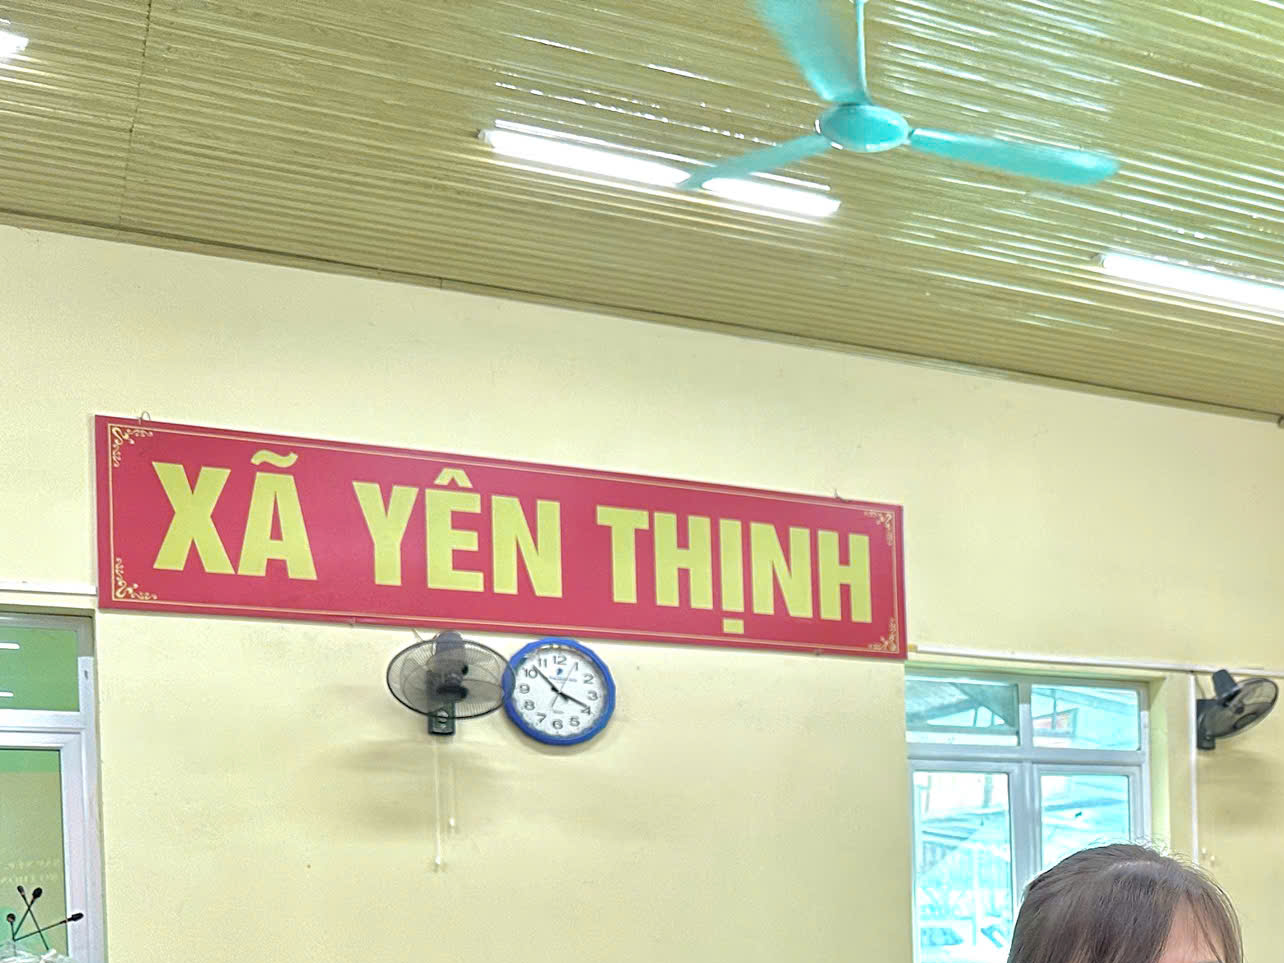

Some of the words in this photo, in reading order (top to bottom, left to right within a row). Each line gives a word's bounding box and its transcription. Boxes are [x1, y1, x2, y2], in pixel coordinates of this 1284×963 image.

[151, 449, 318, 581] XÃ
[352, 467, 563, 599] YÊN
[596, 505, 873, 635] THỊNH
[538, 658, 548, 668] 11
[552, 655, 567, 665] 12
[524, 668, 538, 679] 10
[583, 673, 594, 685] 2
[519, 683, 530, 694] 9
[587, 690, 598, 701] 3
[524, 699, 535, 711] 8
[581, 705, 591, 715] 4
[537, 712, 546, 724] 7
[569, 716, 580, 727] 5
[552, 719, 563, 730] 6
